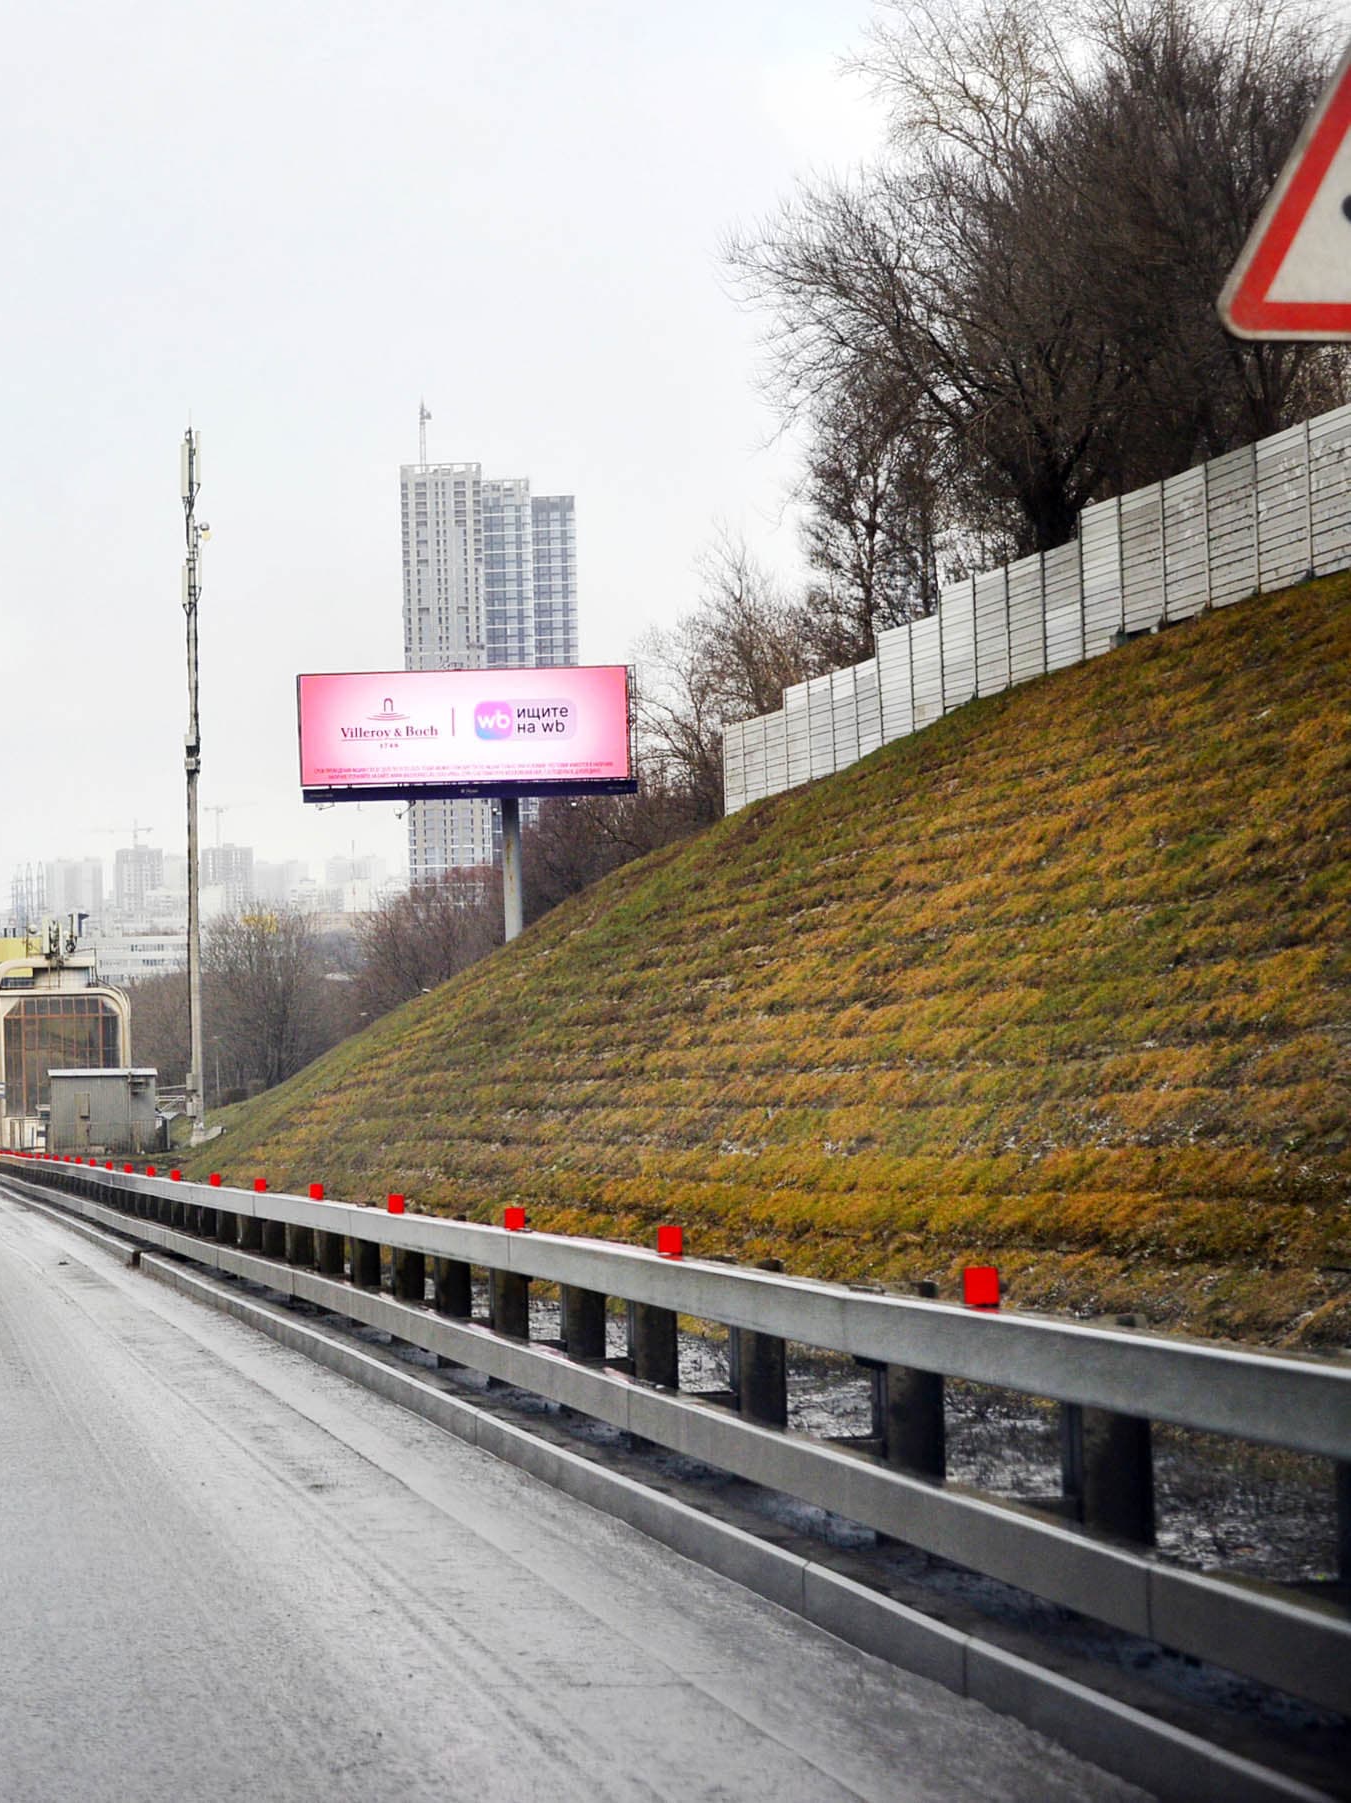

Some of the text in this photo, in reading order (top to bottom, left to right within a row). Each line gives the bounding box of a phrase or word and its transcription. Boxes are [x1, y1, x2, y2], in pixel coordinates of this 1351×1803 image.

[477, 709, 511, 729] wb
[516, 706, 569, 720] ищите
[340, 725, 439, 739] Villeroy & Boch
[517, 720, 566, 734] на wb
